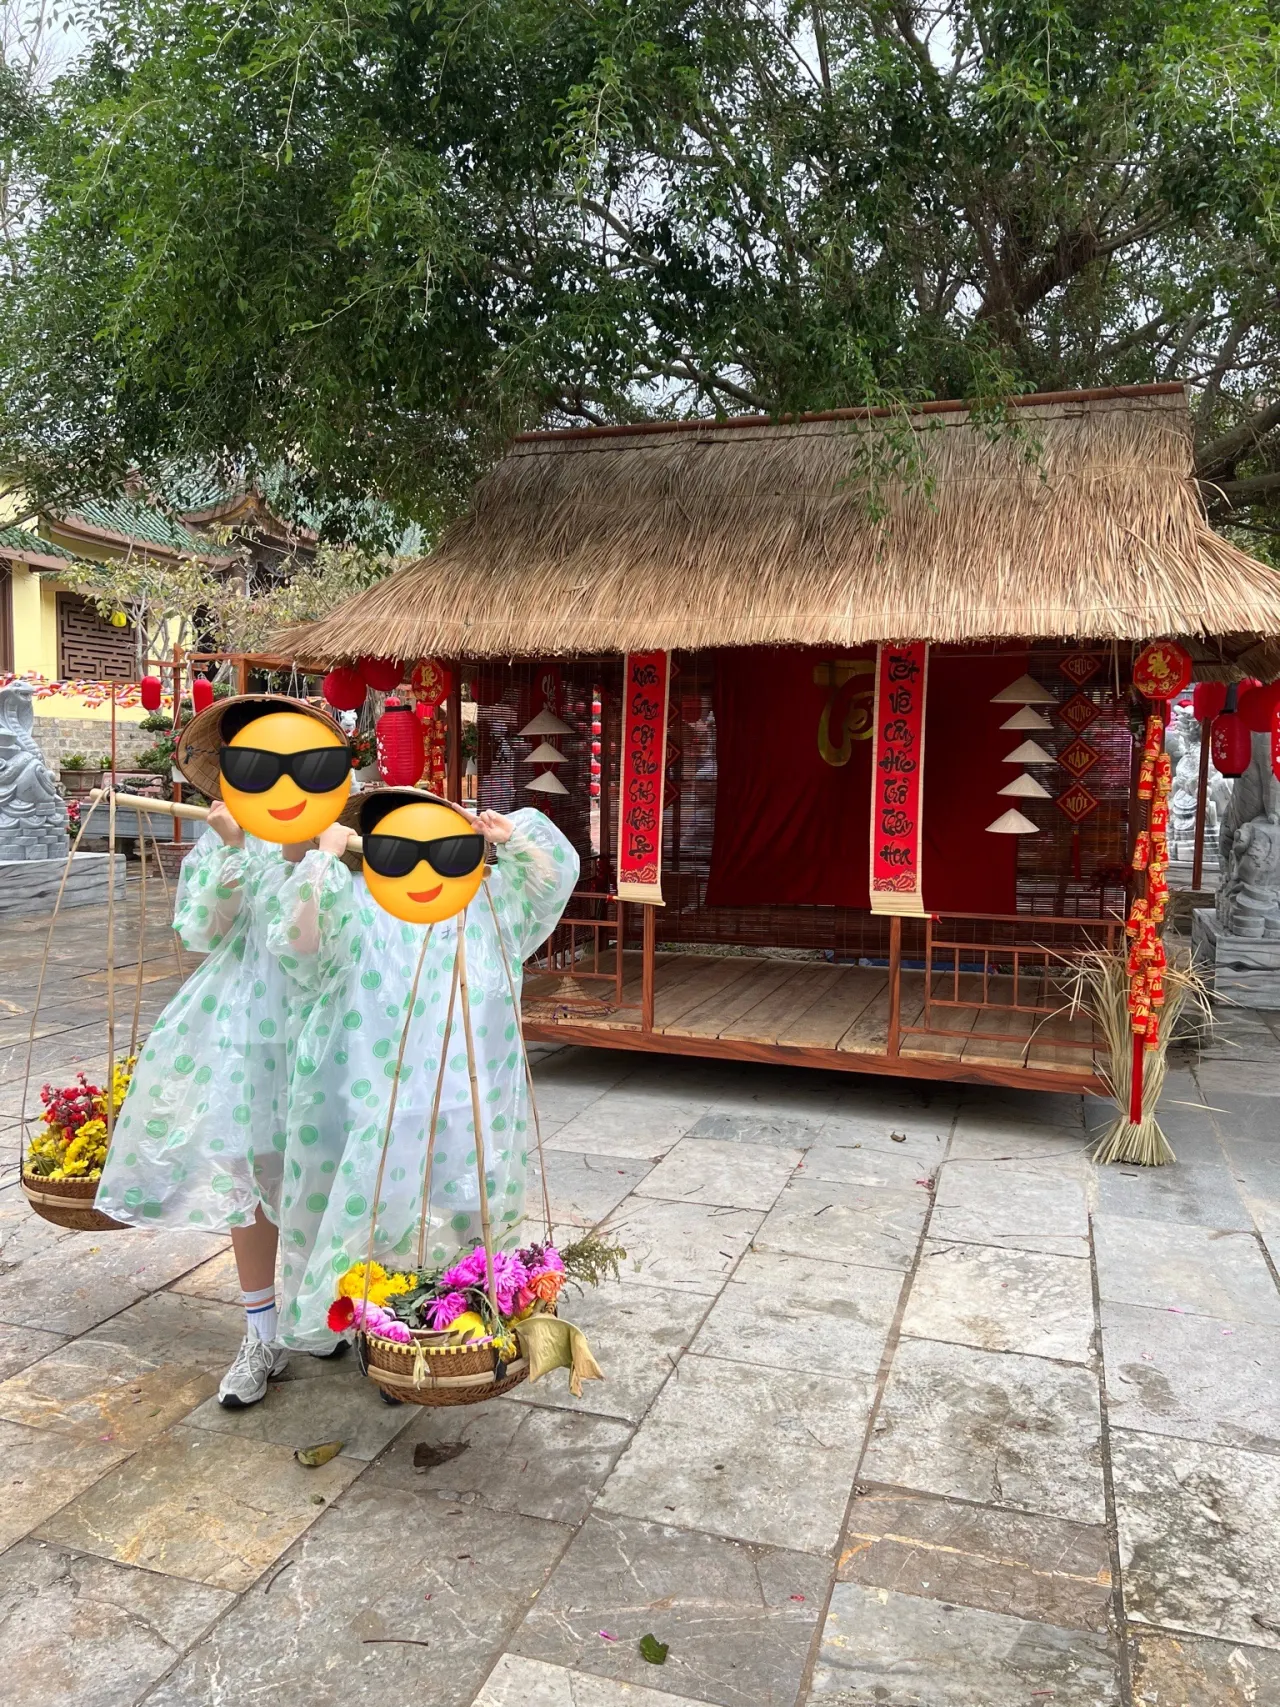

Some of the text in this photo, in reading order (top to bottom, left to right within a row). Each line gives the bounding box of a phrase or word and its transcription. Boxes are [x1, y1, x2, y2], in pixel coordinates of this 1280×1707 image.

[632, 663, 660, 687] Xuân
[889, 651, 920, 684] Tết
[1068, 655, 1093, 676] CHÚC
[888, 685, 913, 714] Về
[1068, 700, 1091, 722] MỪNG
[884, 719, 915, 748] Cây
[629, 778, 656, 805] Sinh
[884, 777, 910, 804] Trổ
[1066, 792, 1088, 813] MỚI
[629, 833, 654, 859] Lộc
[880, 841, 912, 867] Hoa
